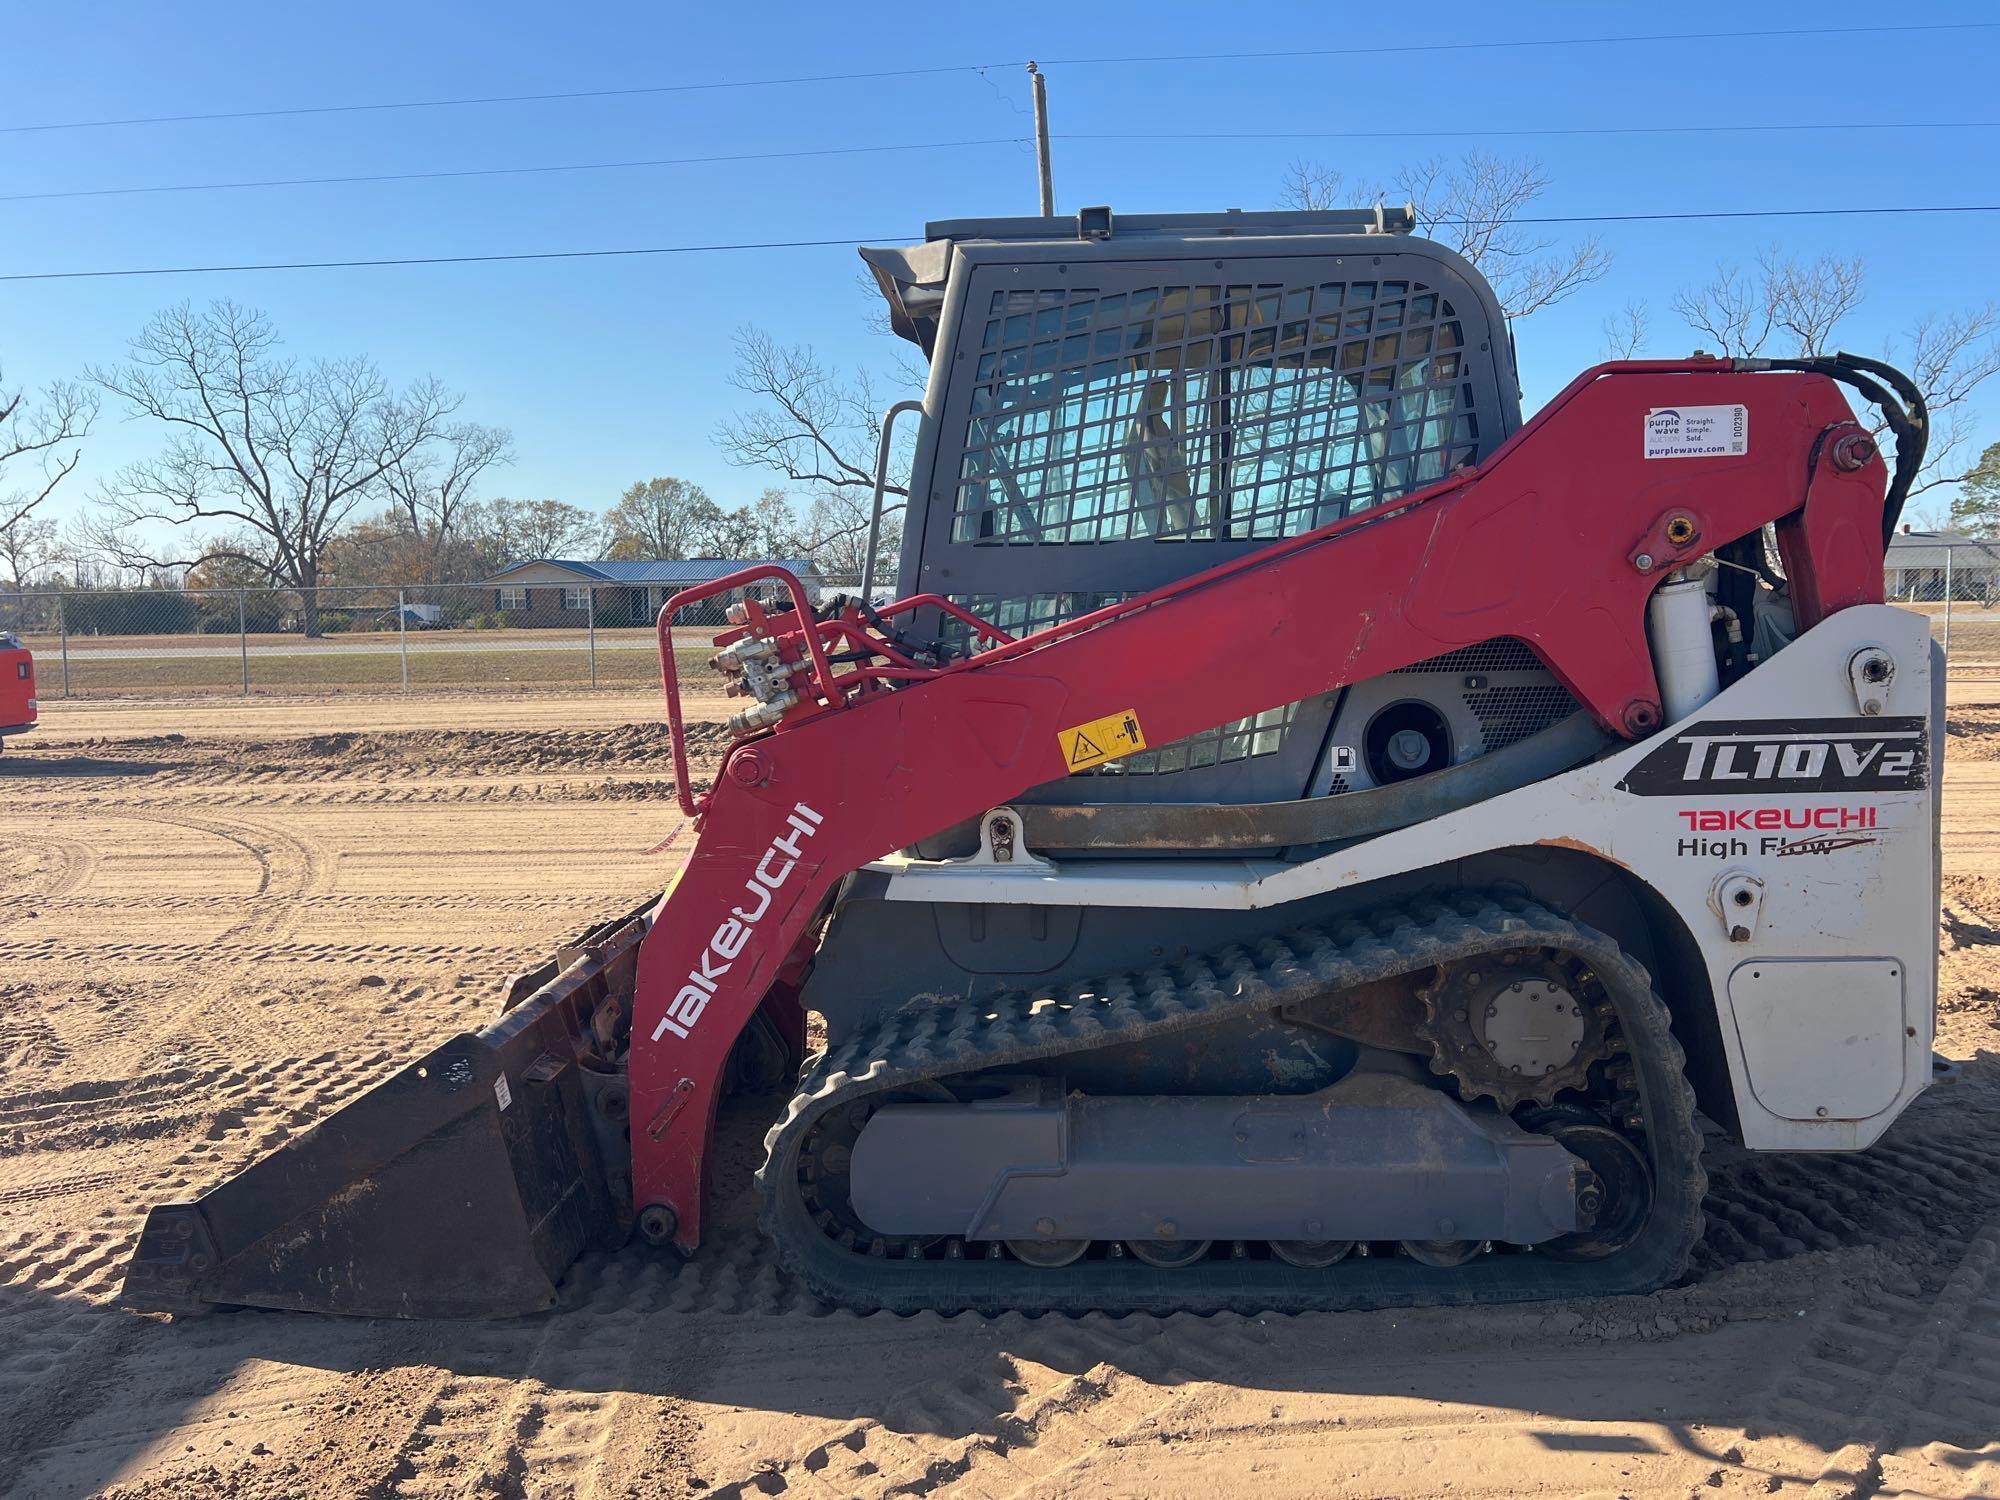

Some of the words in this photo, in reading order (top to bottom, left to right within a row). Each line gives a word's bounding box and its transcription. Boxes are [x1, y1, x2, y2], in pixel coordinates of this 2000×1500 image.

[1649, 417, 1680, 428] purple
[1686, 418, 1716, 426] Straight.
[1649, 446, 1725, 456] purplewave.com
[1677, 838, 1748, 860] High
